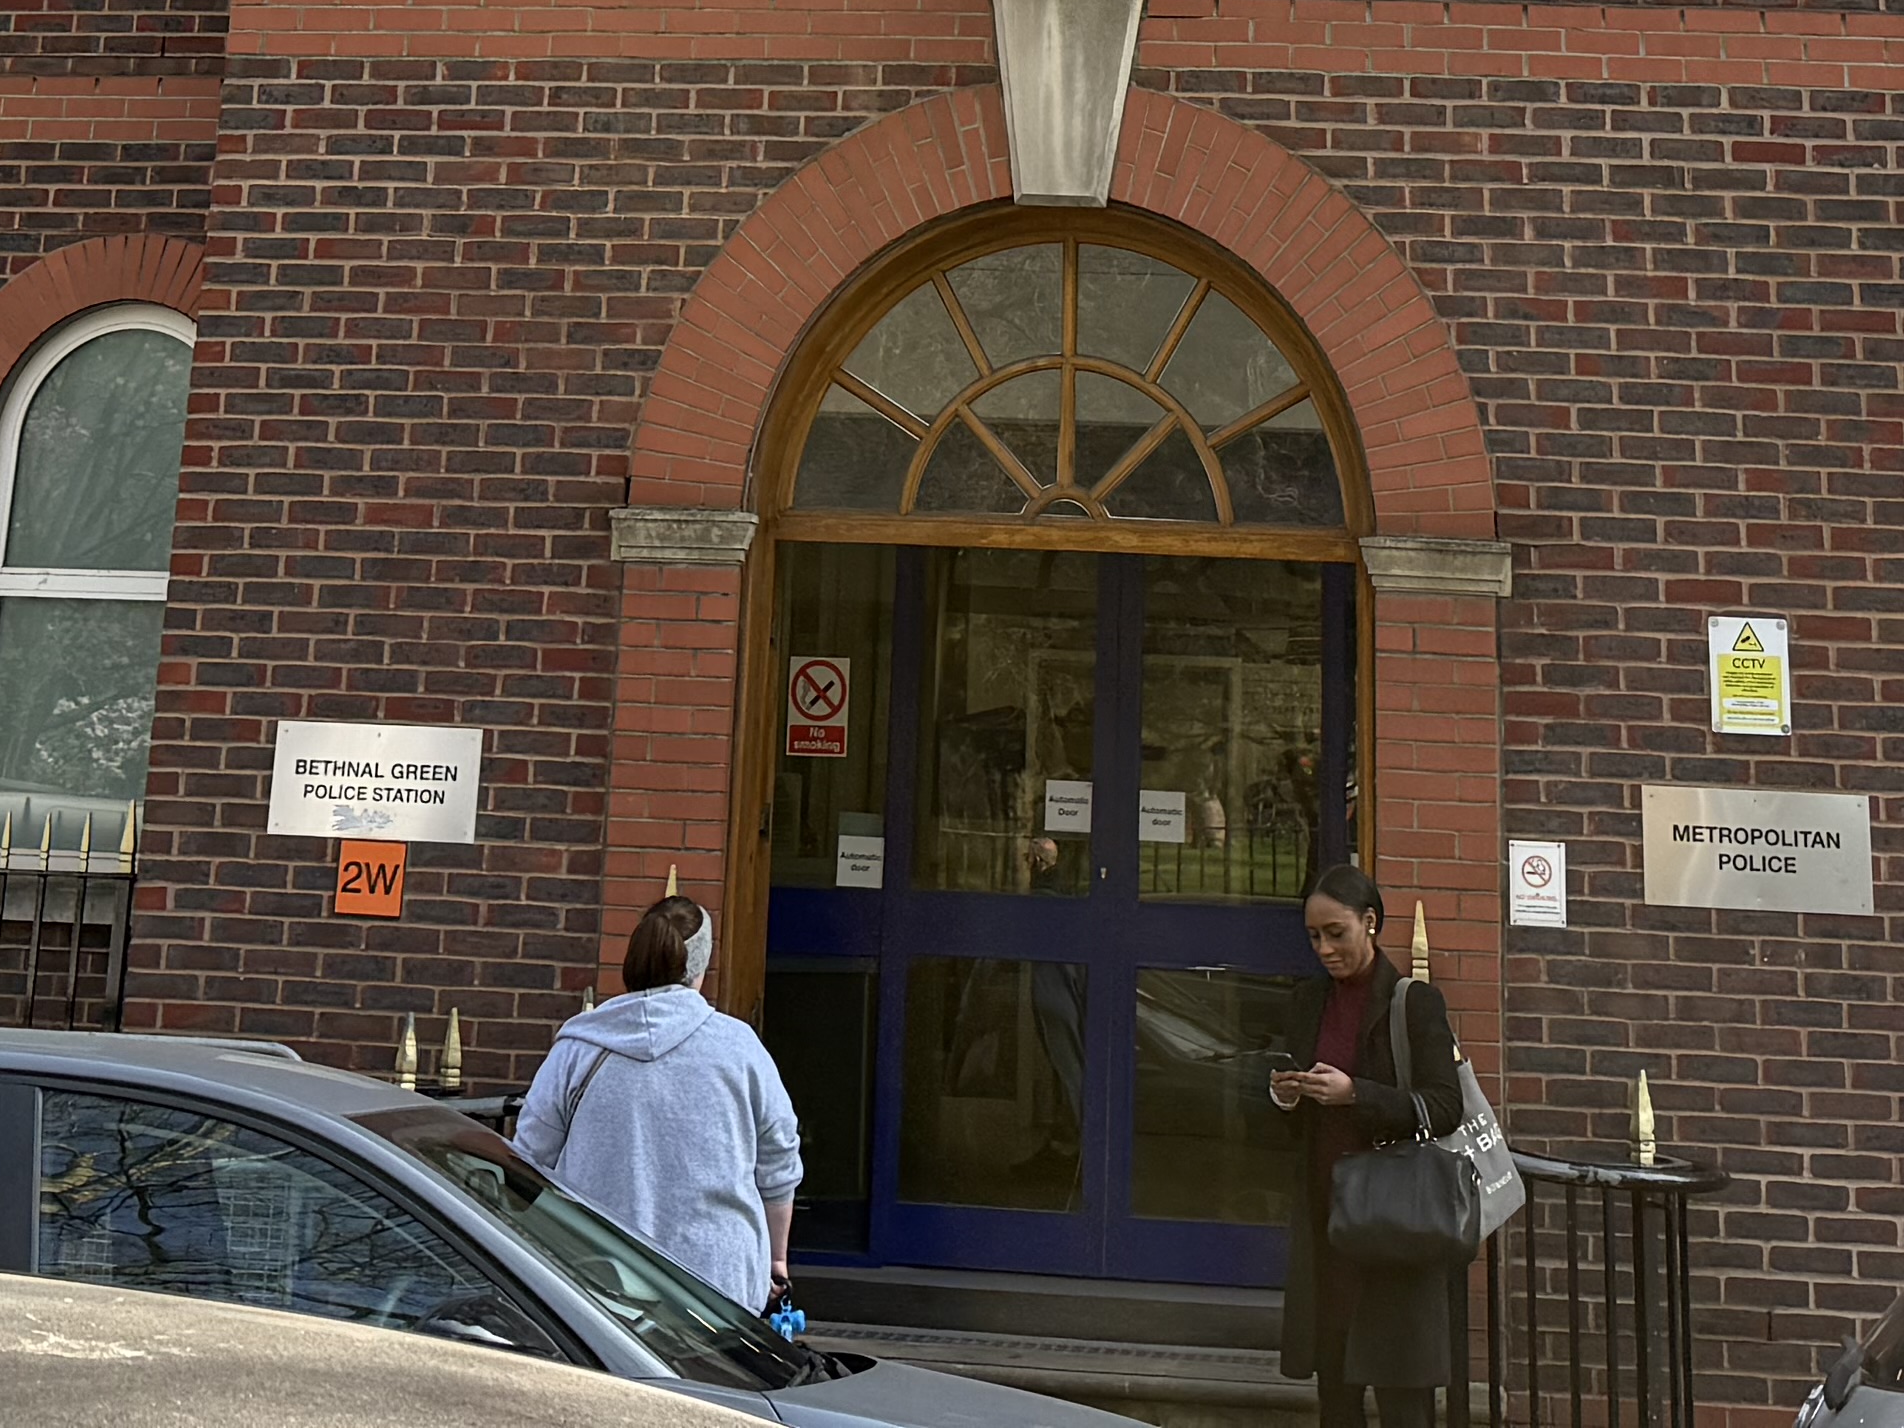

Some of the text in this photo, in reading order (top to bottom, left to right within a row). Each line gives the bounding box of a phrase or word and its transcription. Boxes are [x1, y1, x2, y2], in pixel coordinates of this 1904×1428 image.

[1732, 657, 1766, 669] CCTV
[809, 726, 826, 738] No
[793, 739, 841, 753] smoking
[294, 758, 458, 782] BETHNAL GREEN
[303, 783, 445, 805] POLICE STATION
[1048, 794, 1089, 805] Automatic
[1057, 807, 1078, 817] Door
[1141, 806, 1183, 816] Automatic
[1151, 818, 1172, 826] door
[1672, 824, 1841, 850] METROPOLITAN
[839, 851, 883, 862] Automatic
[850, 863, 871, 872] door
[1718, 853, 1797, 874] POLICE
[340, 860, 400, 896] 2W
[1457, 1112, 1488, 1137] THE
